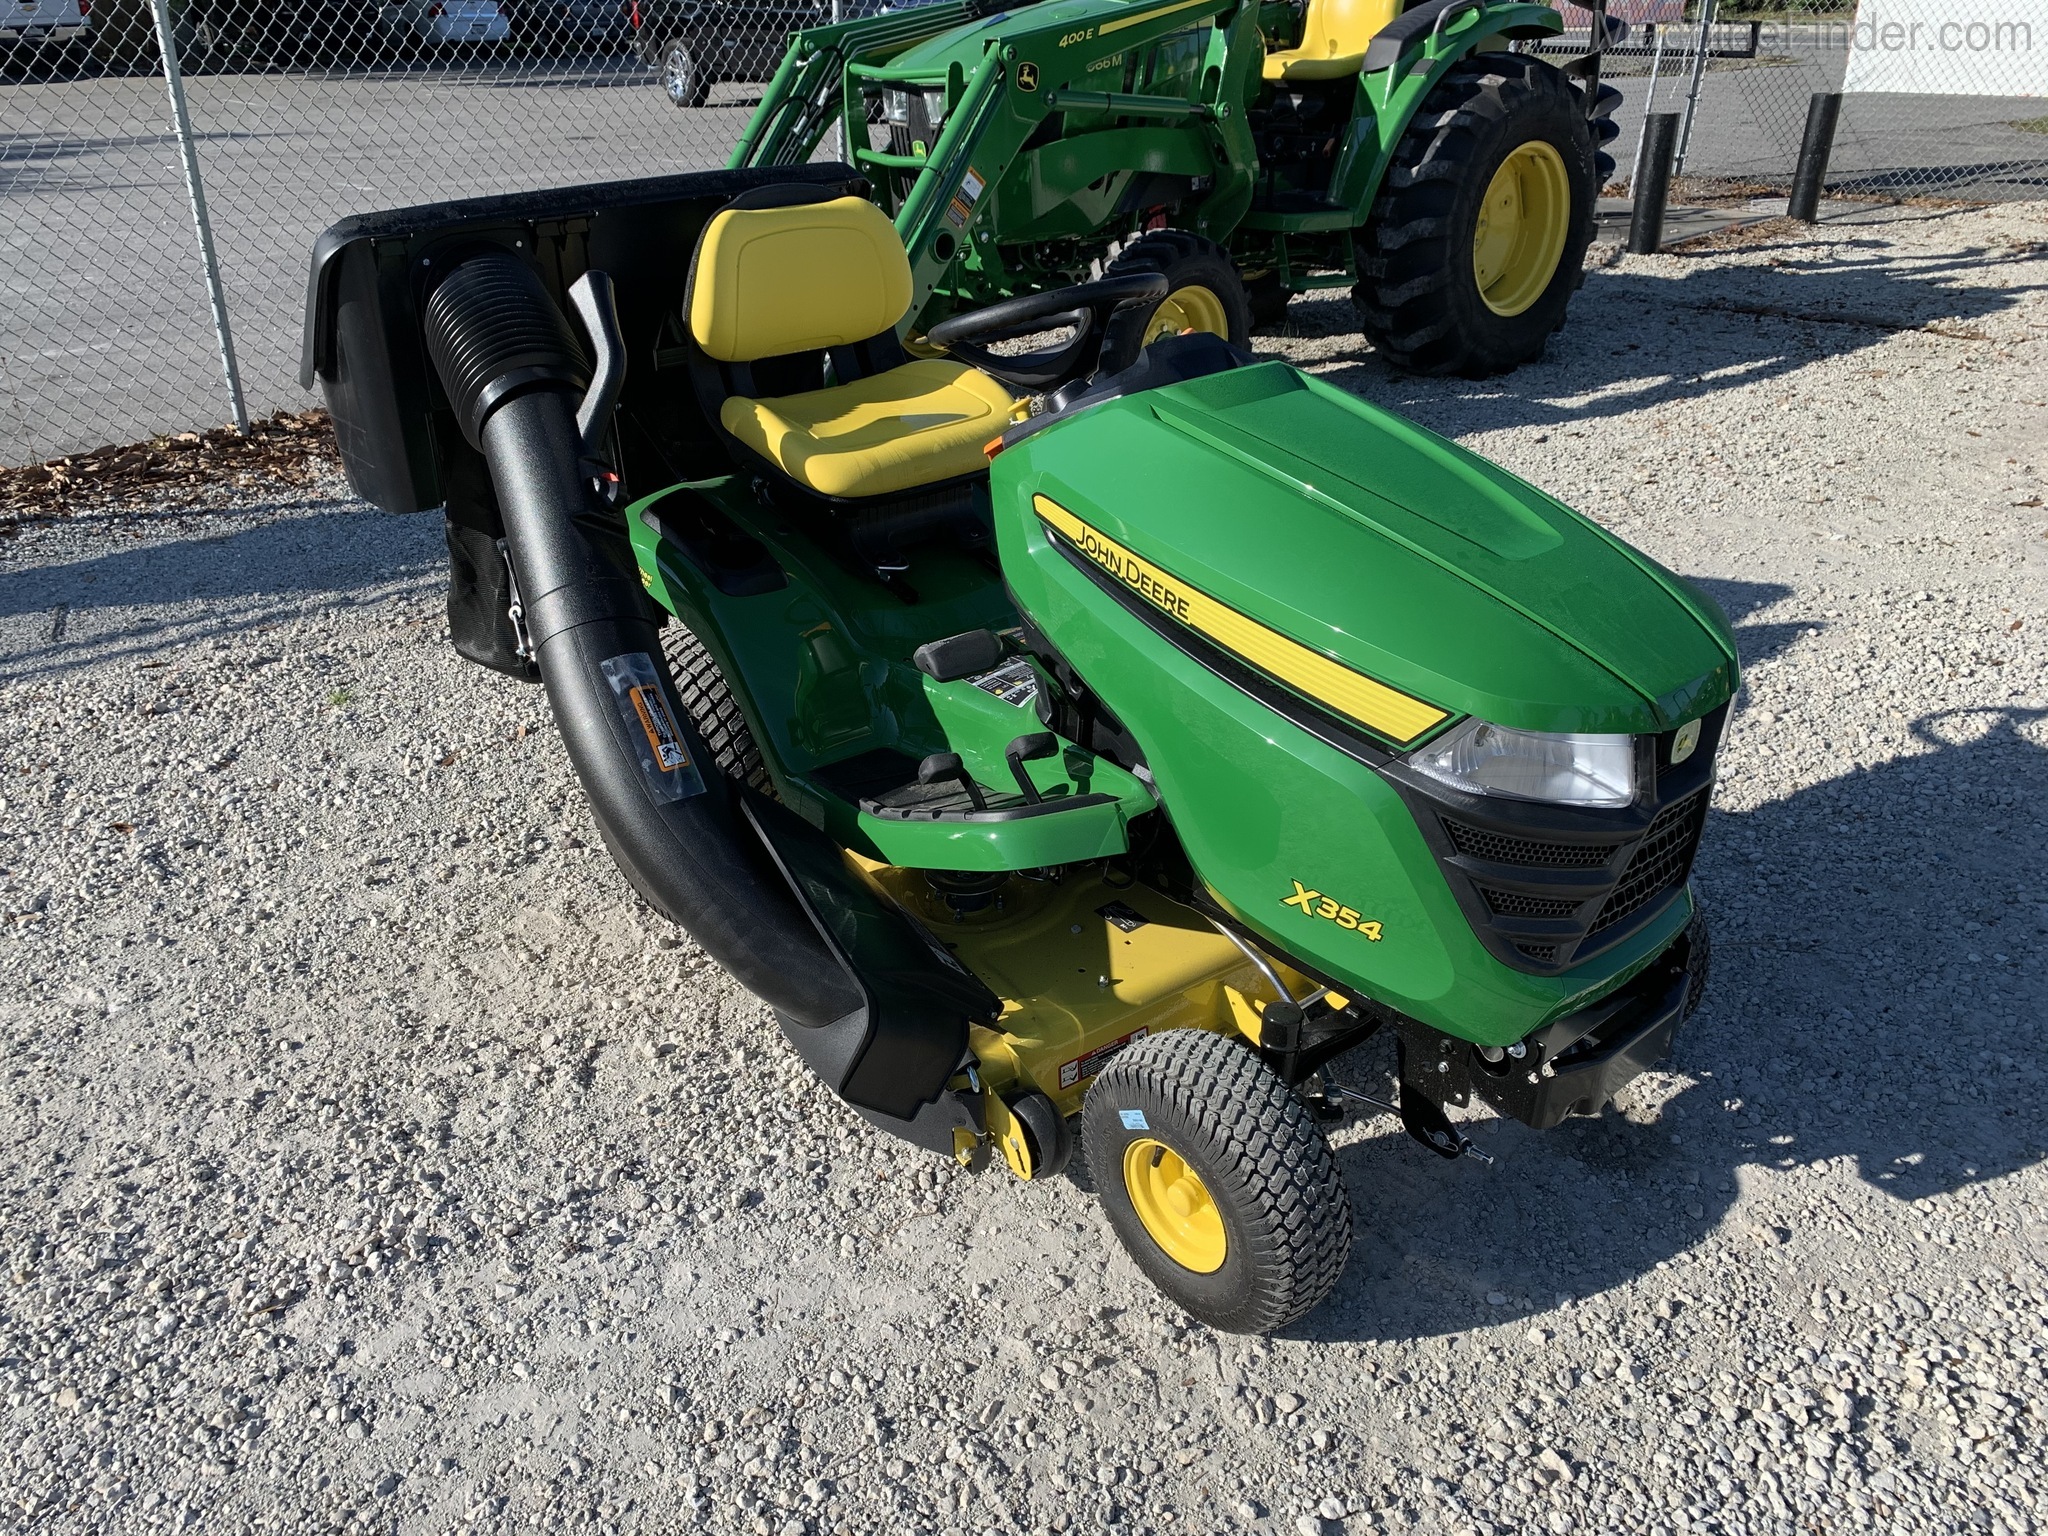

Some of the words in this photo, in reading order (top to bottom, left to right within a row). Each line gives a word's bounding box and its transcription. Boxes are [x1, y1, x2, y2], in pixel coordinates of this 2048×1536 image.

[1075, 526, 1122, 574] JOHN
[1126, 558, 1190, 621] DEERE
[636, 701, 652, 729] WARNING
[1279, 878, 1384, 942] X354
[1095, 1039, 1119, 1054] DANGER
